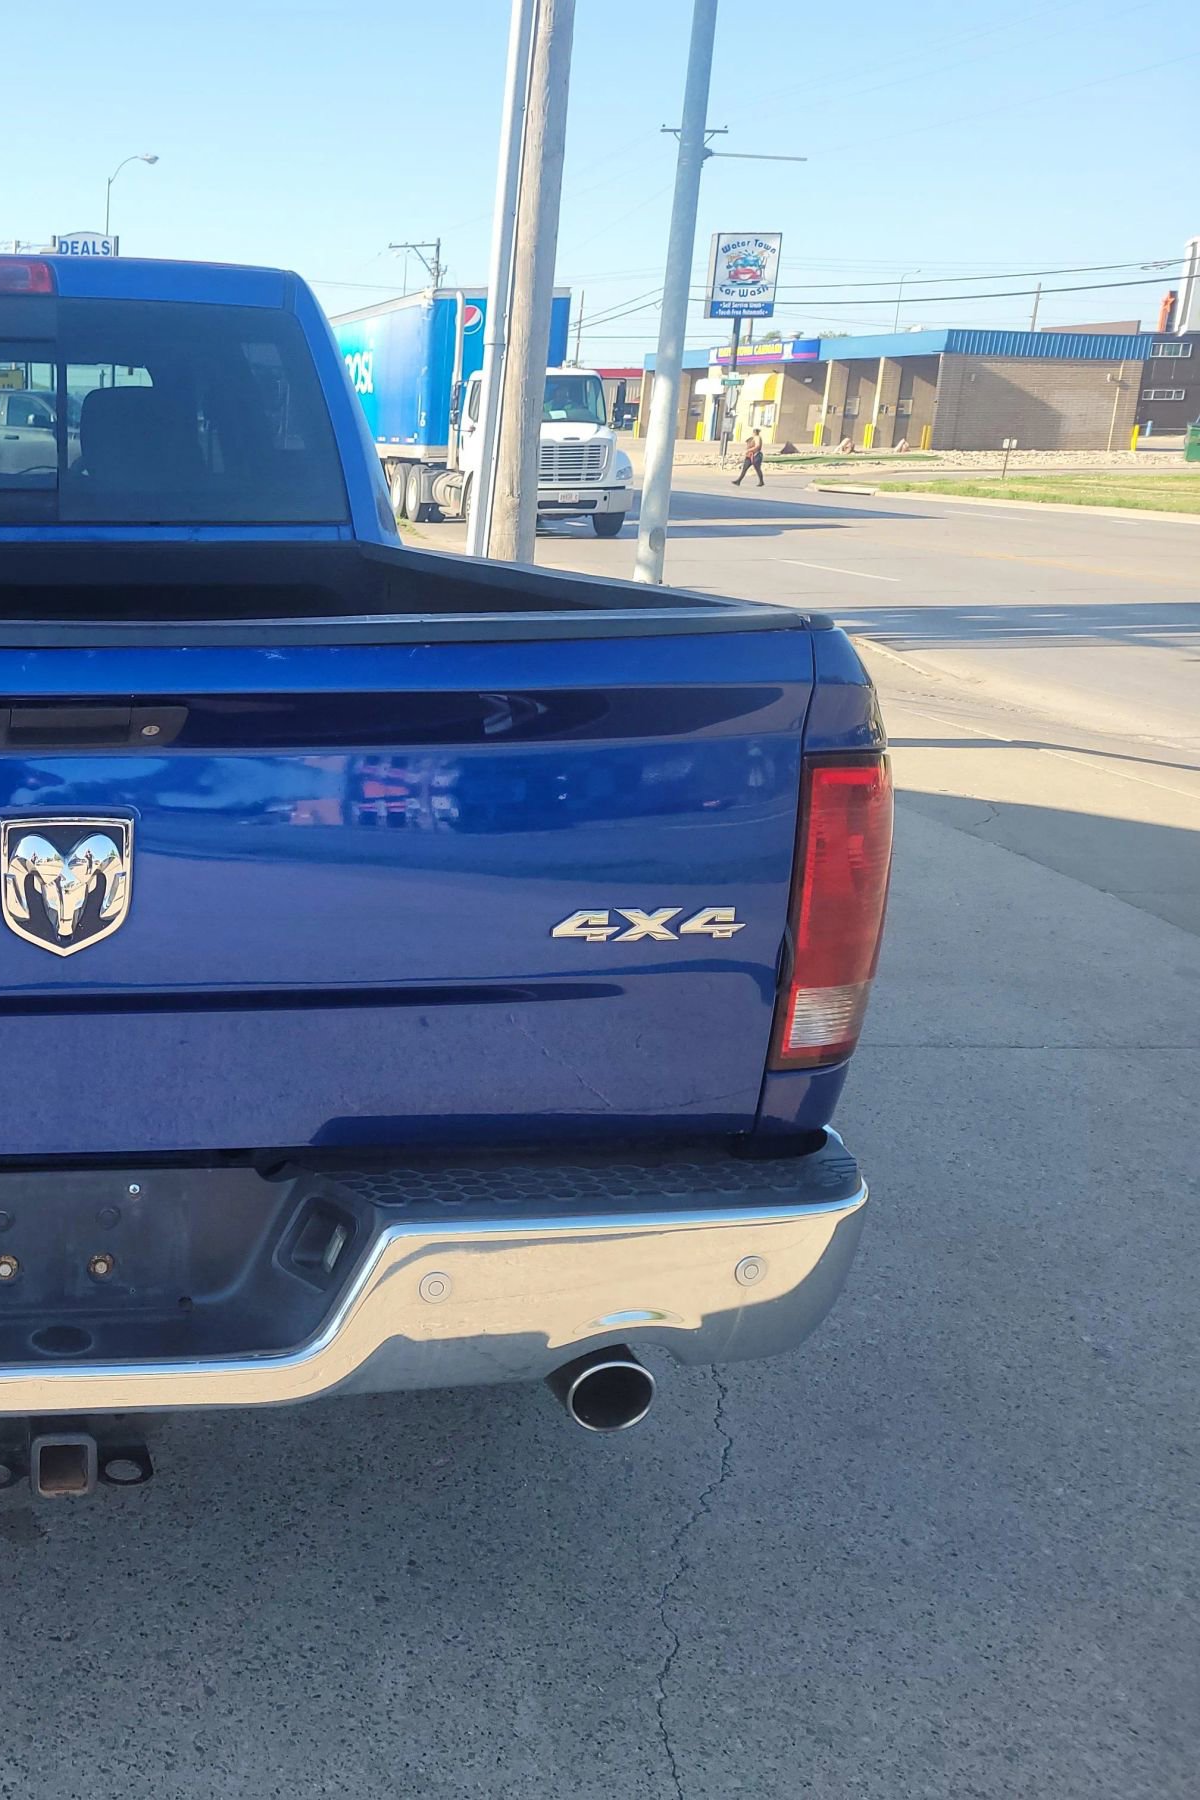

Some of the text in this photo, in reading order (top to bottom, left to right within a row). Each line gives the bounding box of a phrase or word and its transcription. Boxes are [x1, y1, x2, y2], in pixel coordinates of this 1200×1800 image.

[60, 240, 110, 255] DEALS
[721, 239, 777, 254] Water Town
[552, 907, 747, 942] 4X4
